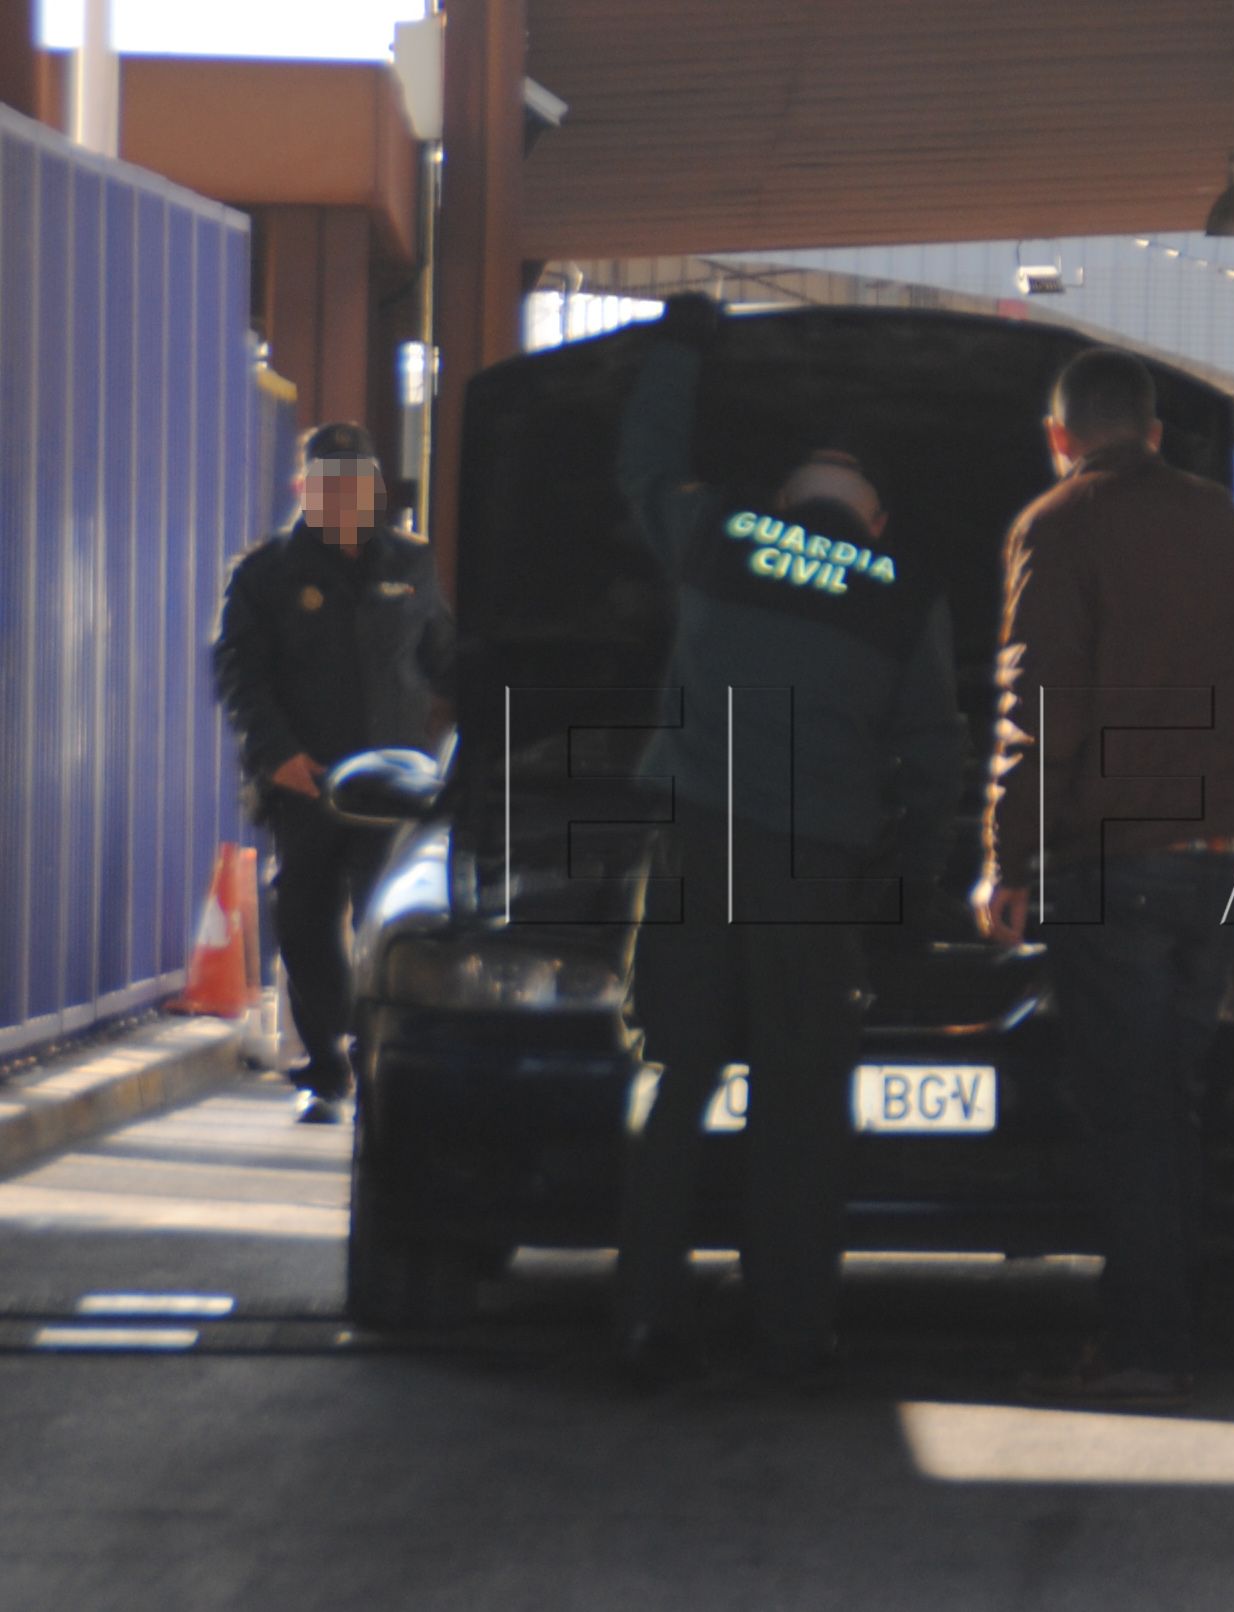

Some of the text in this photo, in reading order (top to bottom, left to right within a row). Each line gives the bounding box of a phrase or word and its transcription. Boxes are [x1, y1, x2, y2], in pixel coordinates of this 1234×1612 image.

[726, 511, 896, 583] GUARDIA
[749, 546, 850, 594] CIVIL
[882, 1073, 982, 1122] BGV
